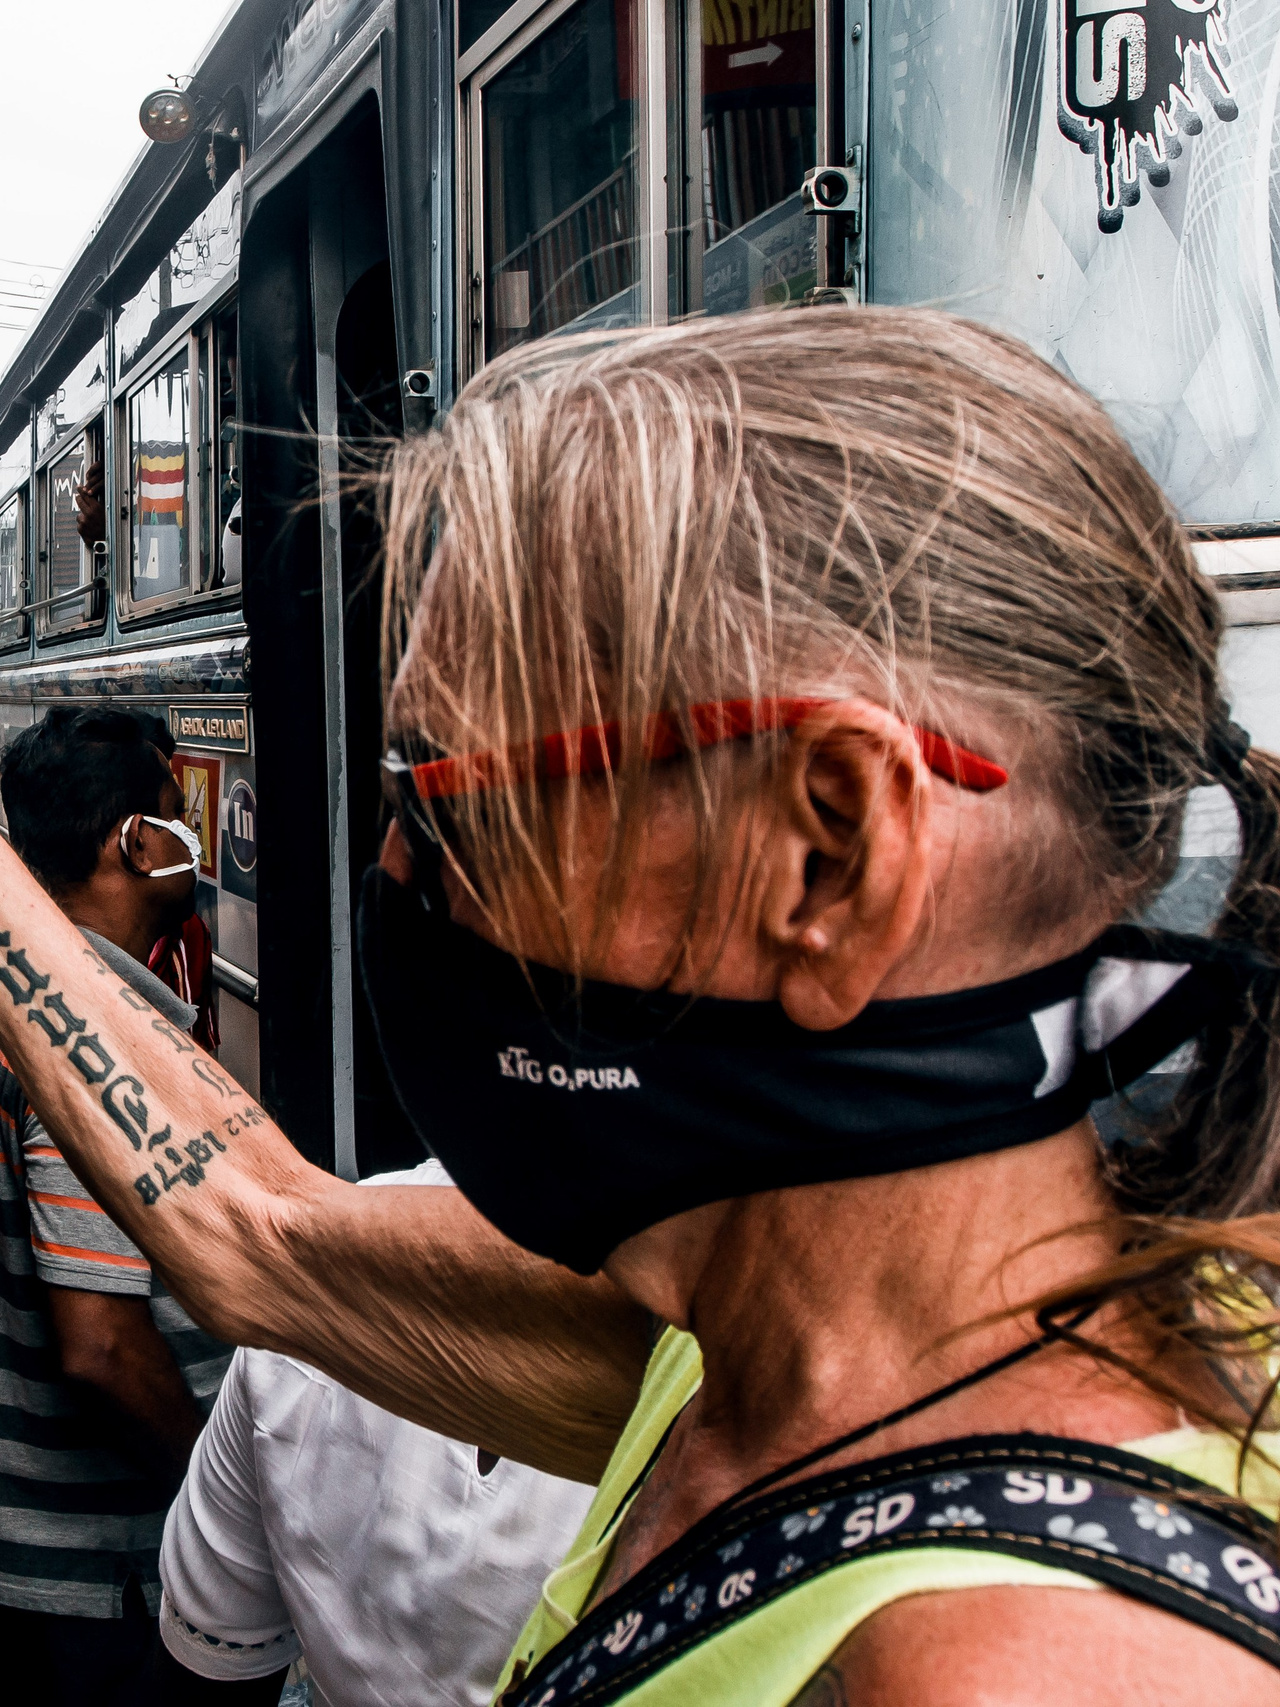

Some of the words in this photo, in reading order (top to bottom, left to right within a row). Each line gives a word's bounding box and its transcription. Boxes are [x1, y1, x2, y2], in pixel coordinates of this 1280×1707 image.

[180, 717, 206, 737] ASHOK
[206, 718, 245, 740] LEYLAND
[1002, 1470, 1094, 1505] SD
[840, 1492, 916, 1549] SD
